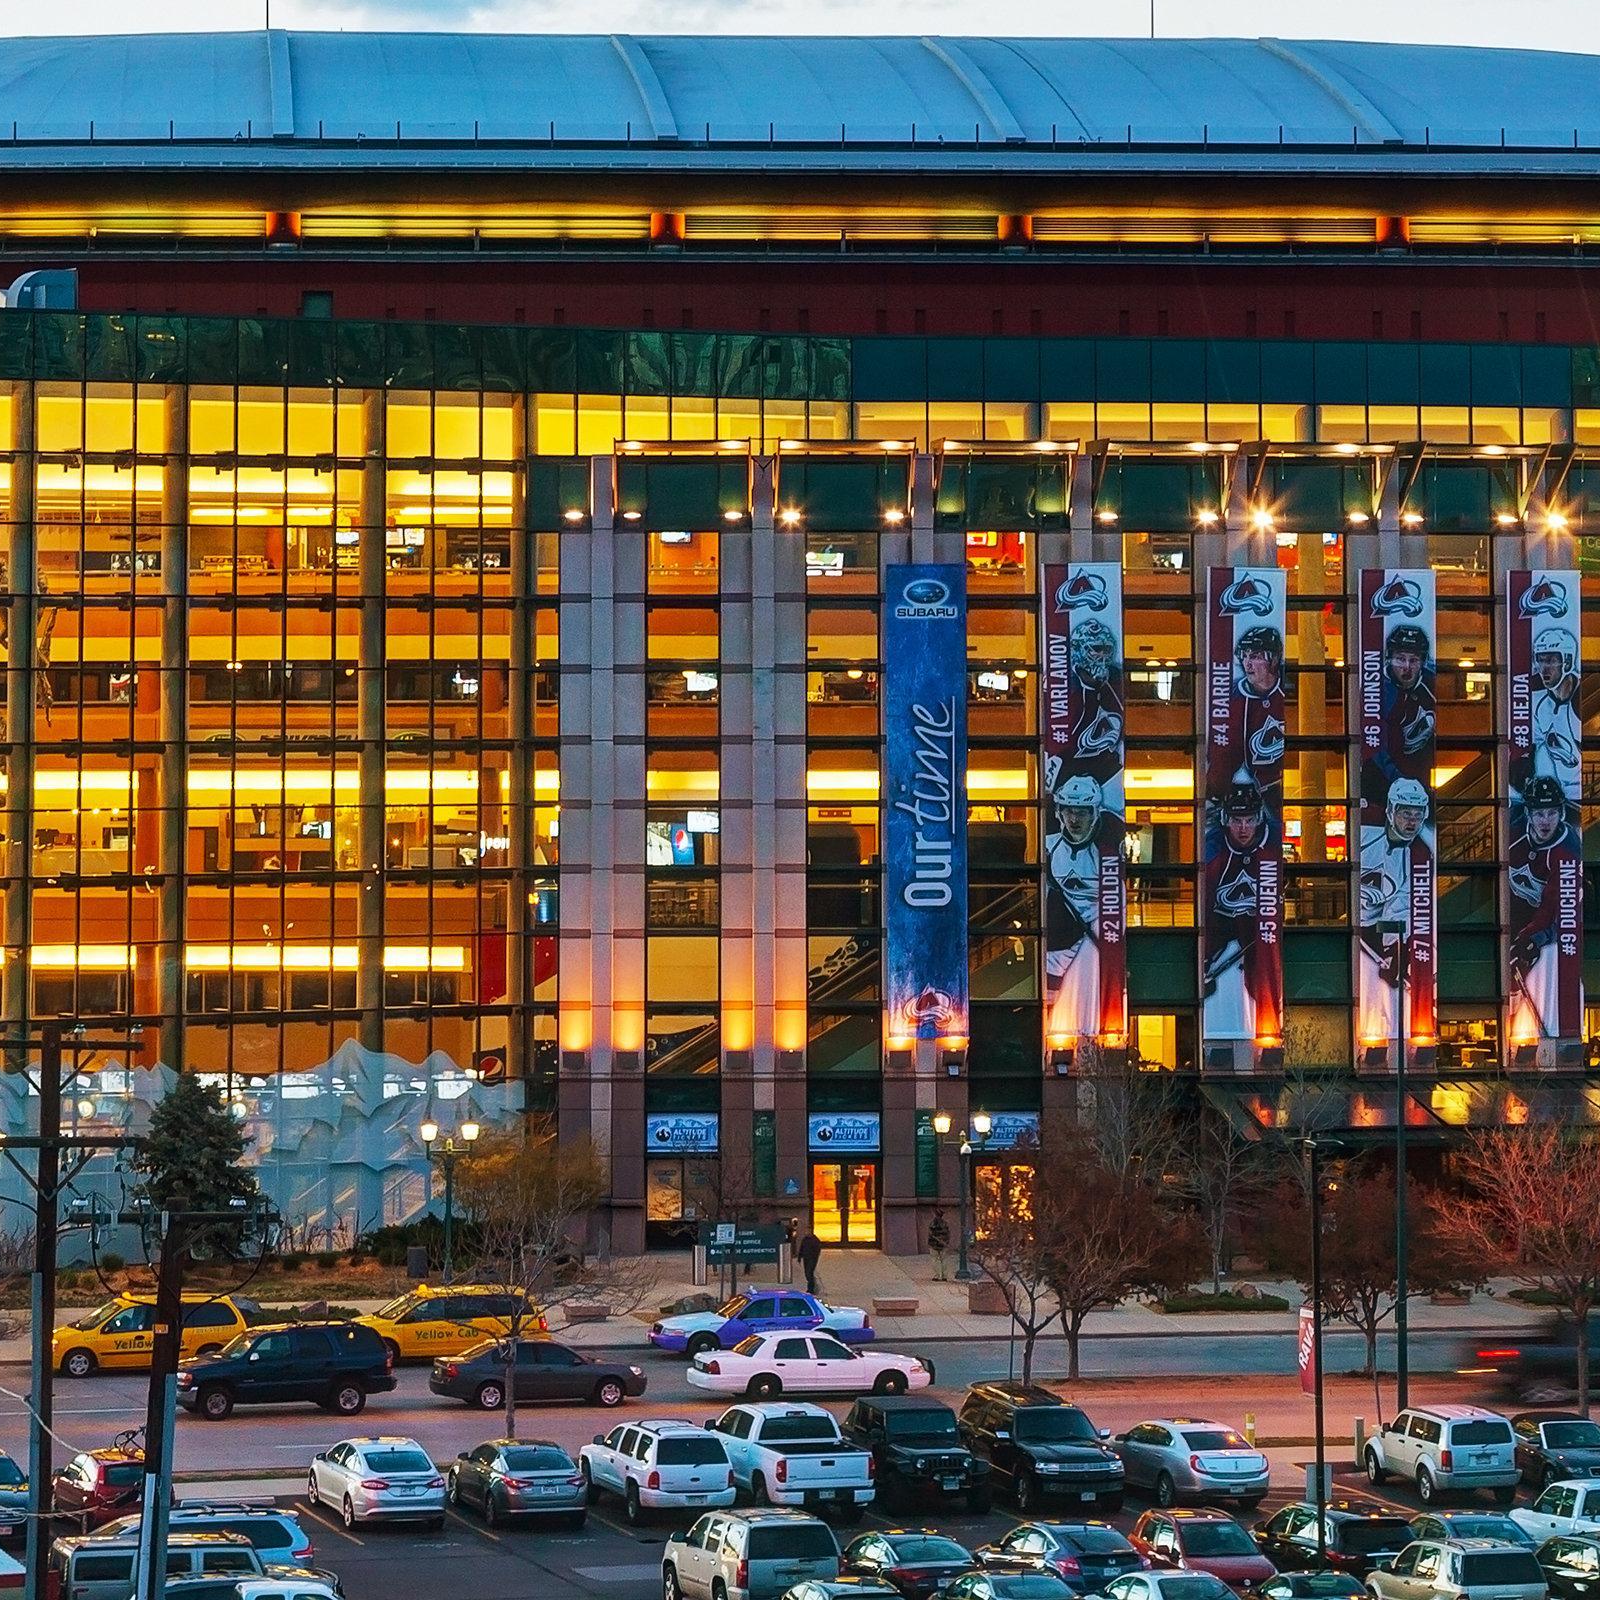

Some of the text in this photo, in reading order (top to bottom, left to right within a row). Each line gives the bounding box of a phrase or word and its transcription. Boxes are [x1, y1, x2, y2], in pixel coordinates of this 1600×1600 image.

[896, 607, 956, 617] SUBARU
[1050, 633, 1069, 744] #1 VARLAMOV
[1212, 661, 1230, 746] #4 BARRIE
[1363, 650, 1382, 747] #6 JOHNSON
[1512, 673, 1530, 748] #8 HEJDA
[895, 700, 953, 907] Our time
[1102, 855, 1120, 944] #2 HOLDEN
[1259, 860, 1278, 944] #5 GUENIN
[1413, 860, 1431, 963] #7 MITCHELL
[1559, 859, 1577, 956] #9 DUCHENE
[415, 1328, 479, 1341] Yellow Cab
